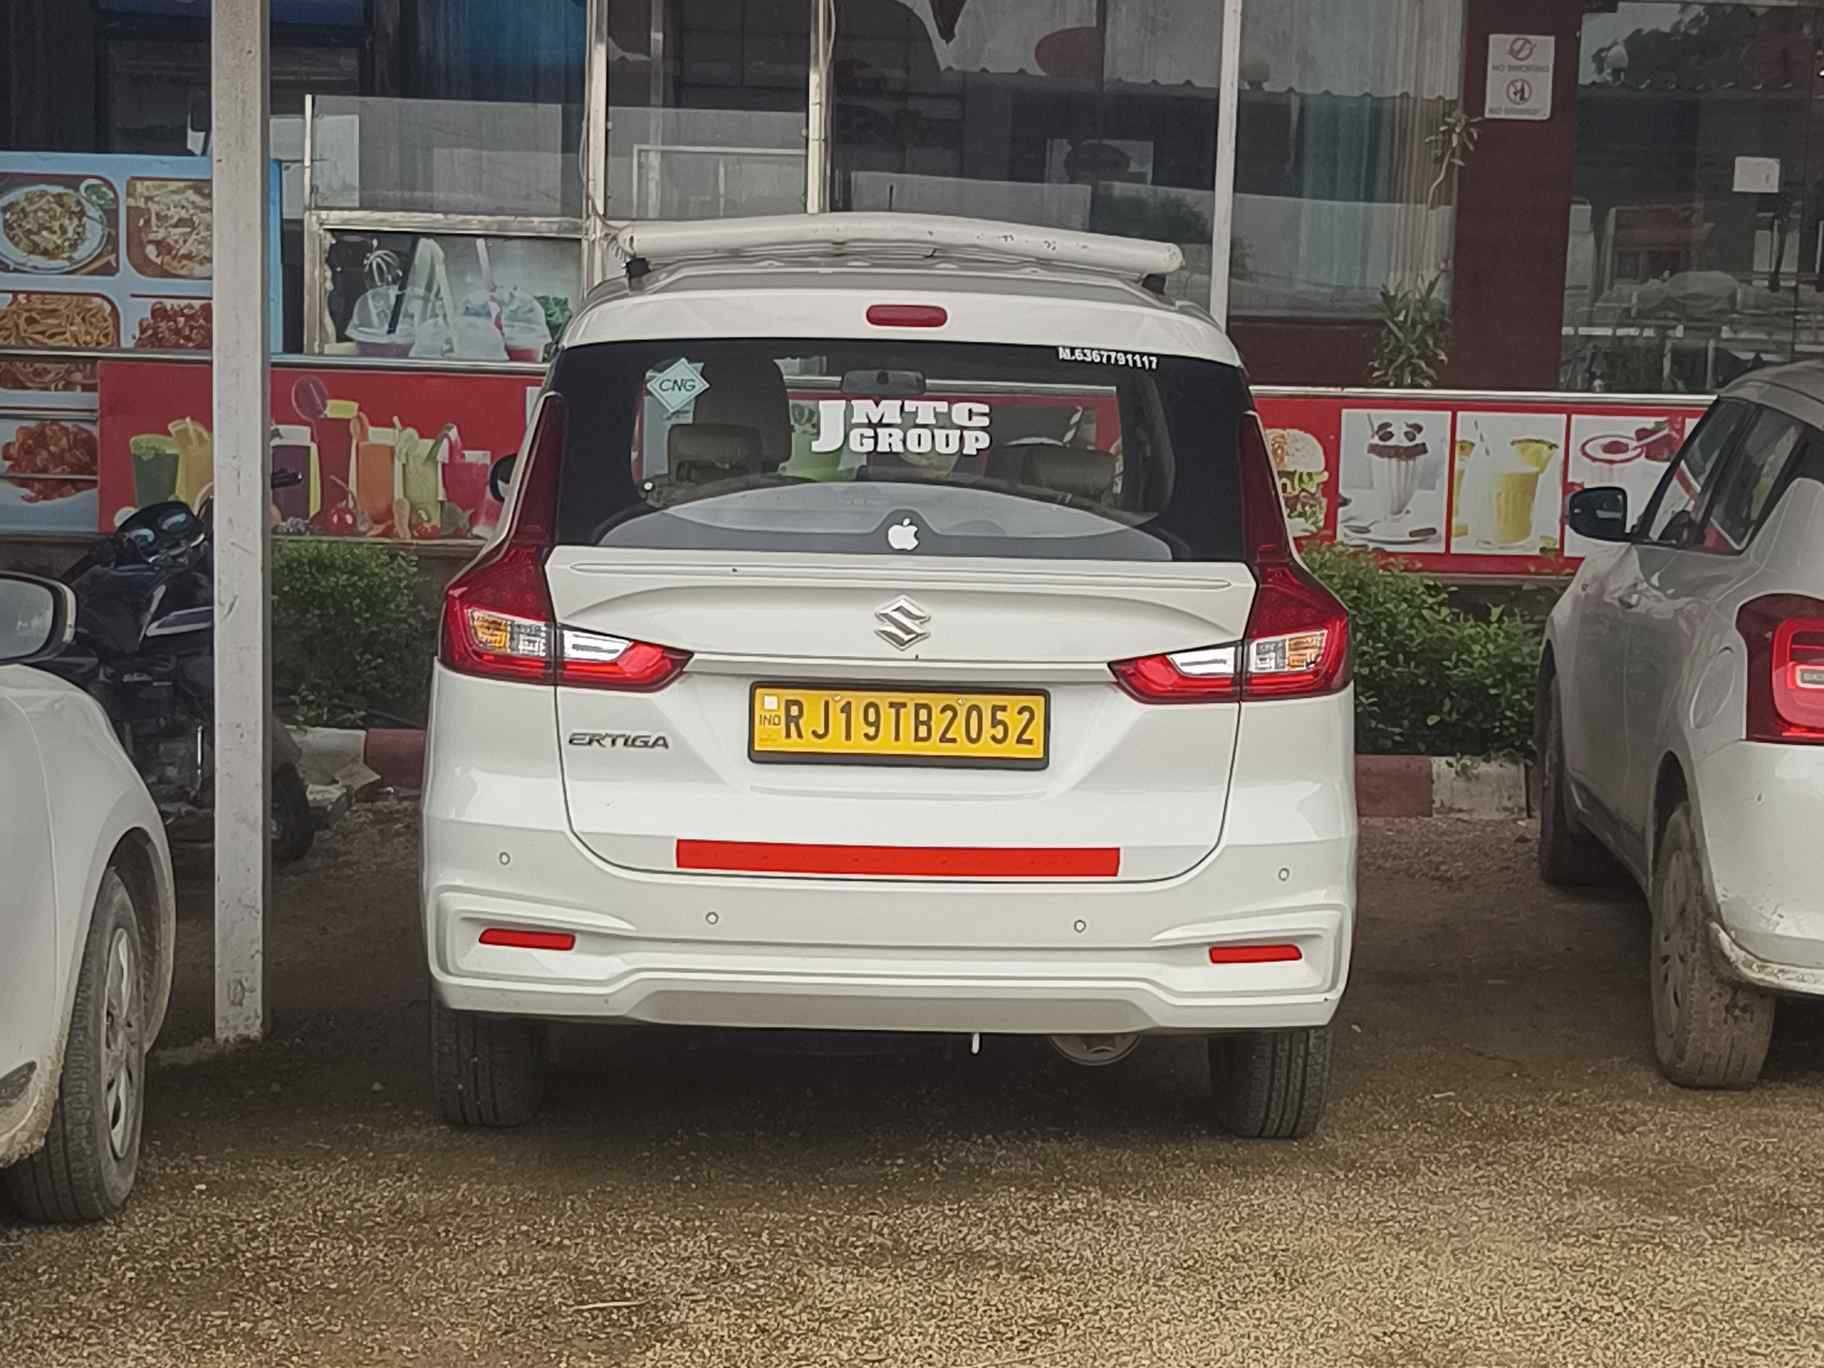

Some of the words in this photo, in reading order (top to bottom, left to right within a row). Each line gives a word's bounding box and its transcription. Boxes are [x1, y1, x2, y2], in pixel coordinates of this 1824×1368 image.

[659, 378, 696, 393] CNG
[850, 428, 991, 455] GROUP
[759, 714, 781, 726] IND
[784, 699, 1036, 746] RJ19TB2052
[568, 732, 670, 750] ERTIGA
